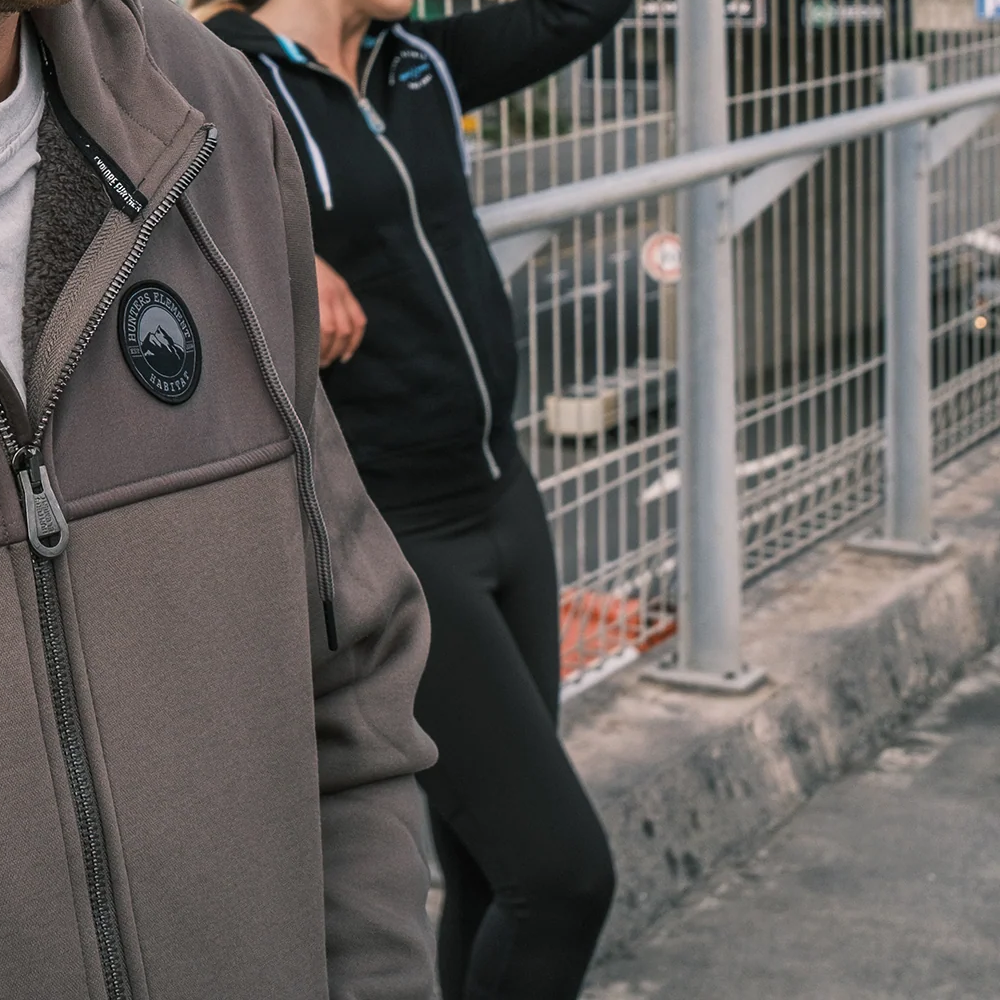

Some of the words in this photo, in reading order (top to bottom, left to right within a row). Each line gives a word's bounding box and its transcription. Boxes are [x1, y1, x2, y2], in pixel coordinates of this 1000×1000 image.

[127, 291, 151, 342] HUNTERS
[153, 291, 191, 339] ELEMENT
[149, 370, 190, 392] HABITAT
